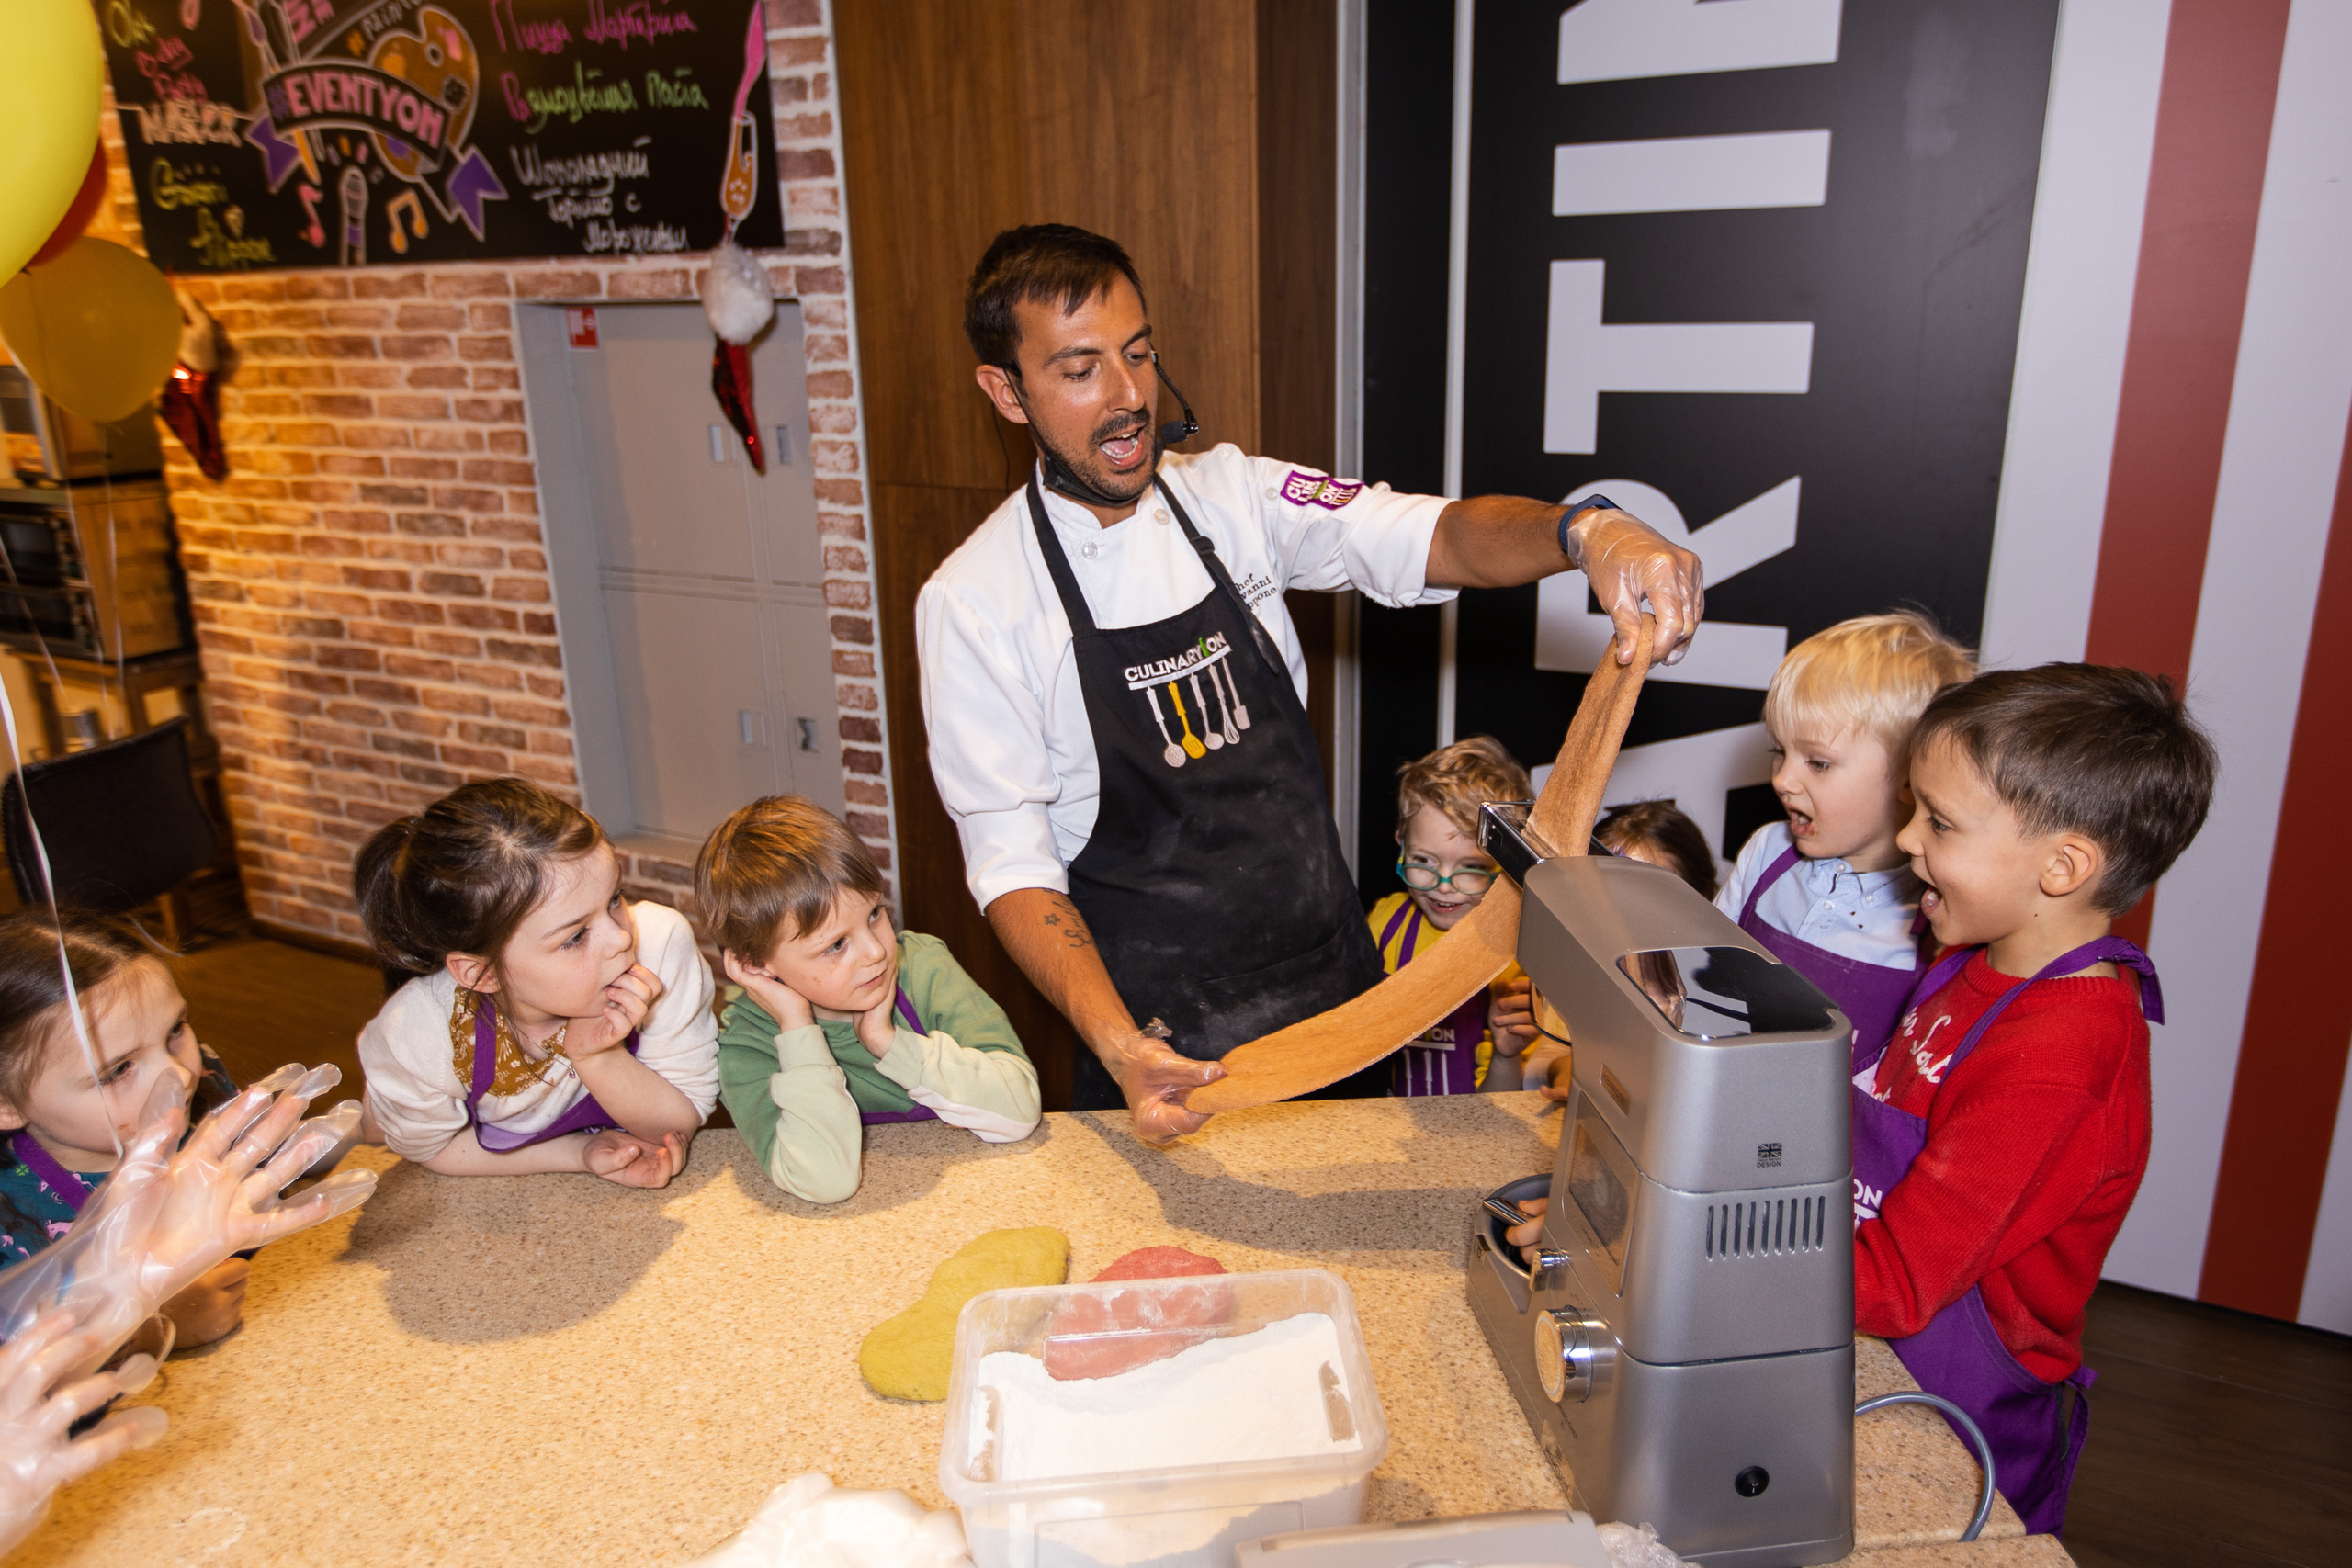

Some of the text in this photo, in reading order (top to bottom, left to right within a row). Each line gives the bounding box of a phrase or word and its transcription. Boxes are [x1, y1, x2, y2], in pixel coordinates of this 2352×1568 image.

[1235, 573, 1254, 591] hef
[1241, 576, 1272, 599] vanni
[1248, 587, 1276, 610] ppone
